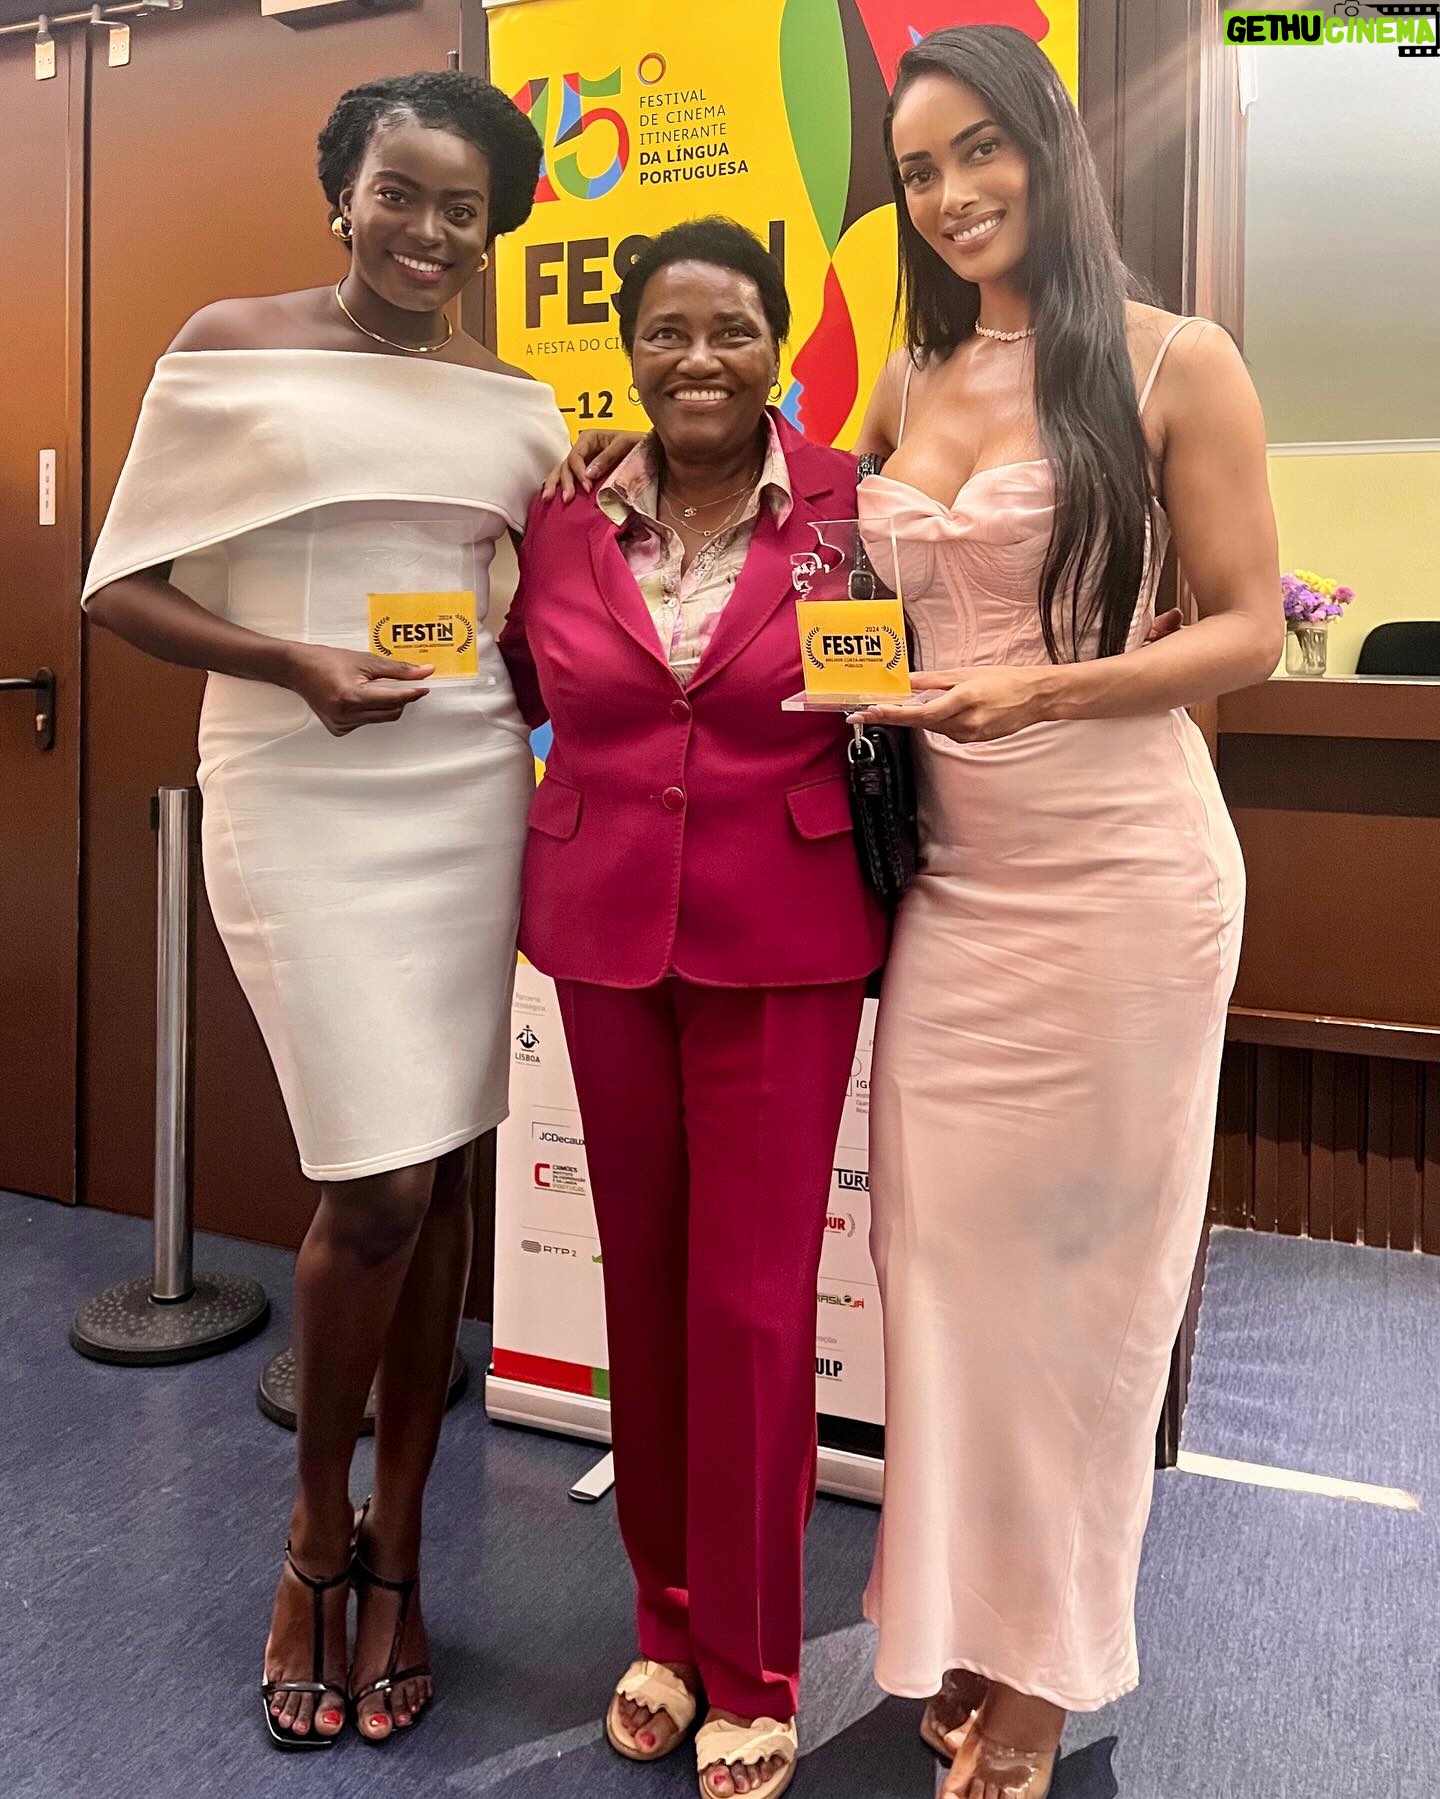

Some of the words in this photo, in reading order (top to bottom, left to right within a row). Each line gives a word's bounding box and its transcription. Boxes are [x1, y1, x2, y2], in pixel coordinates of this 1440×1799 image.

[640, 89, 707, 108] FESTIVAL
[640, 113, 658, 127] DE
[666, 105, 726, 124] CINEMA
[640, 122, 727, 145] ITINERANTE
[640, 151, 661, 165] DA
[667, 142, 729, 163] LÍNGUA
[640, 160, 749, 185] PORTUGUESA
[526, 344, 533, 356] A
[538, 341, 575, 355] FESTA
[580, 339, 600, 351] DO
[515, 1053, 541, 1063] LISBOA
[543, 1245, 570, 1255] RTP
[572, 1249, 577, 1257] 2
